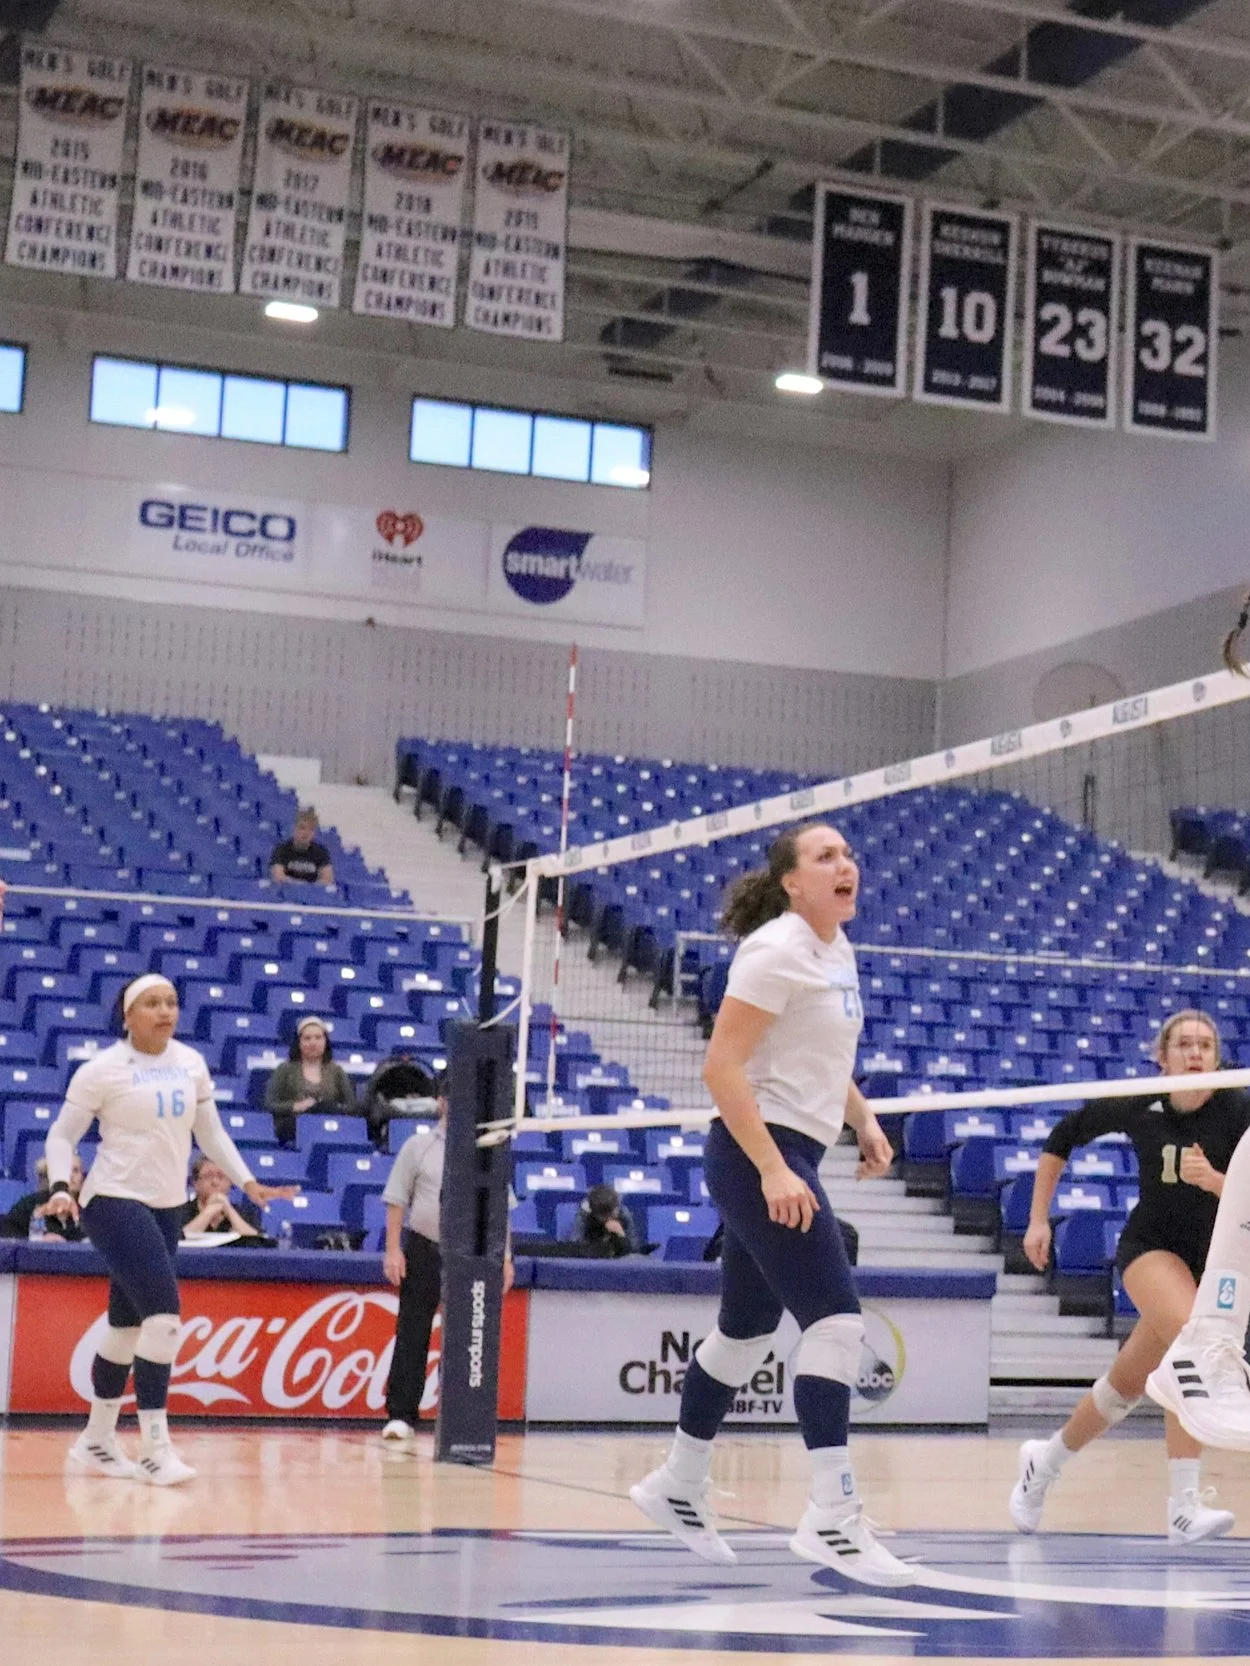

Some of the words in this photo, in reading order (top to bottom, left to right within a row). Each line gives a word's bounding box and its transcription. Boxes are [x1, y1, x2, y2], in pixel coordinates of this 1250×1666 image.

[30, 189, 101, 217] ATHLETIC
[15, 213, 111, 244] CONFERENCE
[151, 209, 220, 236] ATHLETIC
[265, 219, 329, 247] ATHLETIC
[16, 240, 105, 269] CHAMPIONS
[136, 232, 227, 262] CONFERENCE
[249, 245, 340, 275] CONFERENCE
[376, 241, 444, 268] ATHLETIC
[139, 259, 222, 287] CHAMPIONS
[251, 270, 332, 299] CHAMPIONS
[362, 263, 452, 295] CONFERENCE
[483, 258, 547, 285] ATHLETIC
[365, 289, 446, 320] CHAMPIONS
[472, 280, 556, 311] CONFERENCE
[849, 271, 871, 325] 1
[474, 305, 552, 335] CHAMPIONS
[938, 286, 997, 344] 10
[1039, 302, 1107, 363] 23
[1138, 318, 1206, 378] 32
[139, 499, 297, 542] GEICO
[172, 535, 229, 556] Local
[235, 541, 295, 562] Office
[155, 1089, 185, 1119] 16
[857, 1370, 895, 1389] abc
